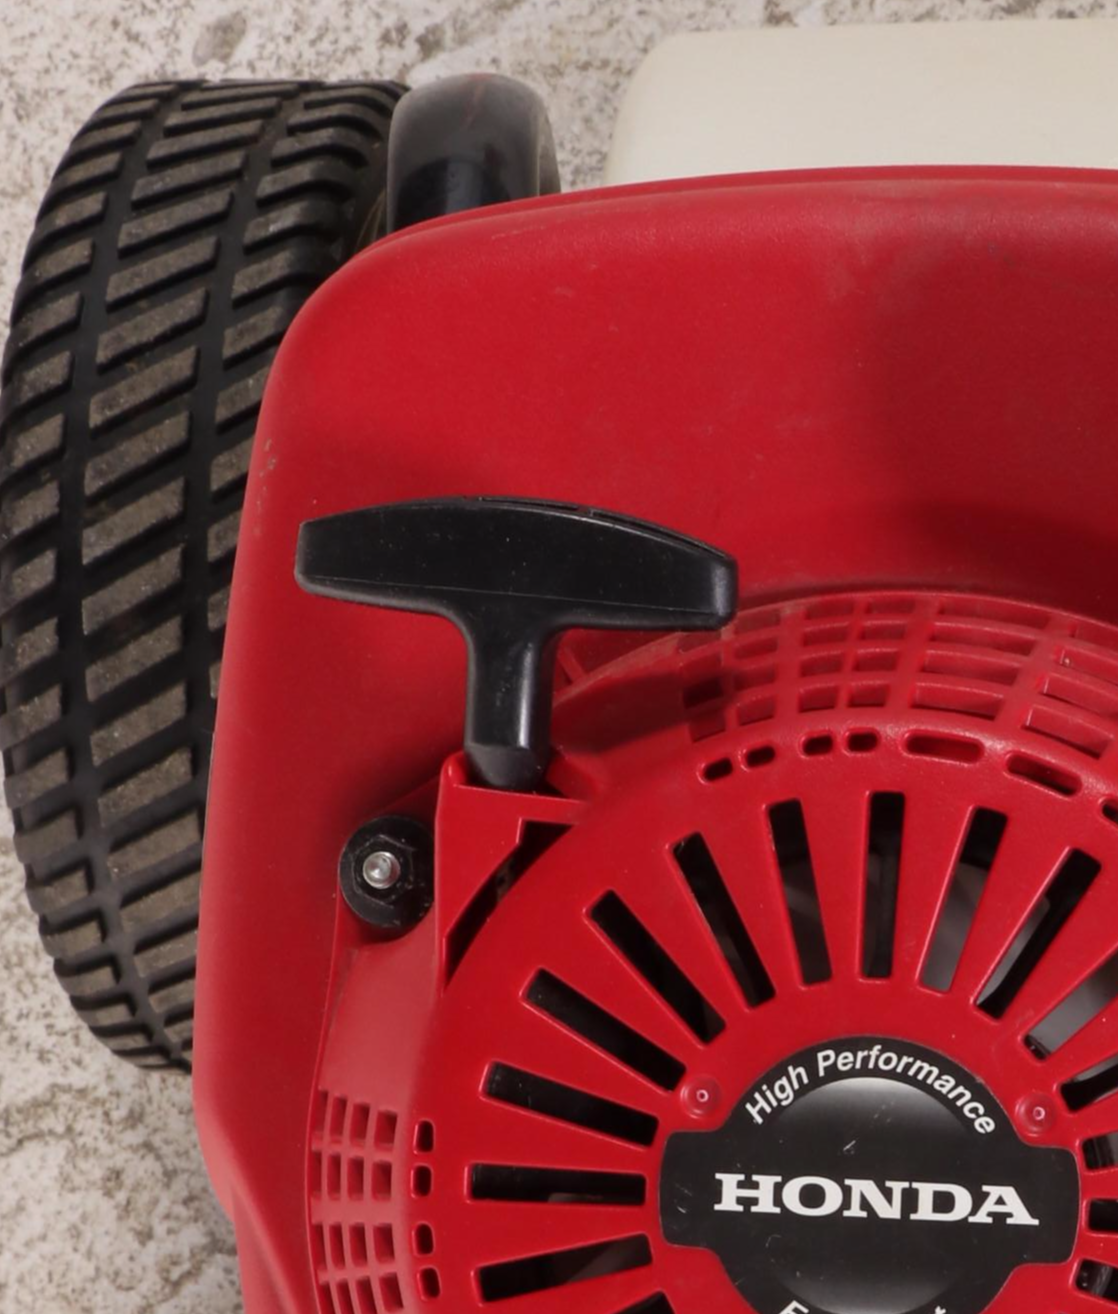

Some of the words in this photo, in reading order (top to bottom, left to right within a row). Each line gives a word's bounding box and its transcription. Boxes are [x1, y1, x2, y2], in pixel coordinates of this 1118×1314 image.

[745, 1063, 810, 1125] High
[816, 1044, 997, 1135] Performance
[713, 1172, 1040, 1226] HONDA
